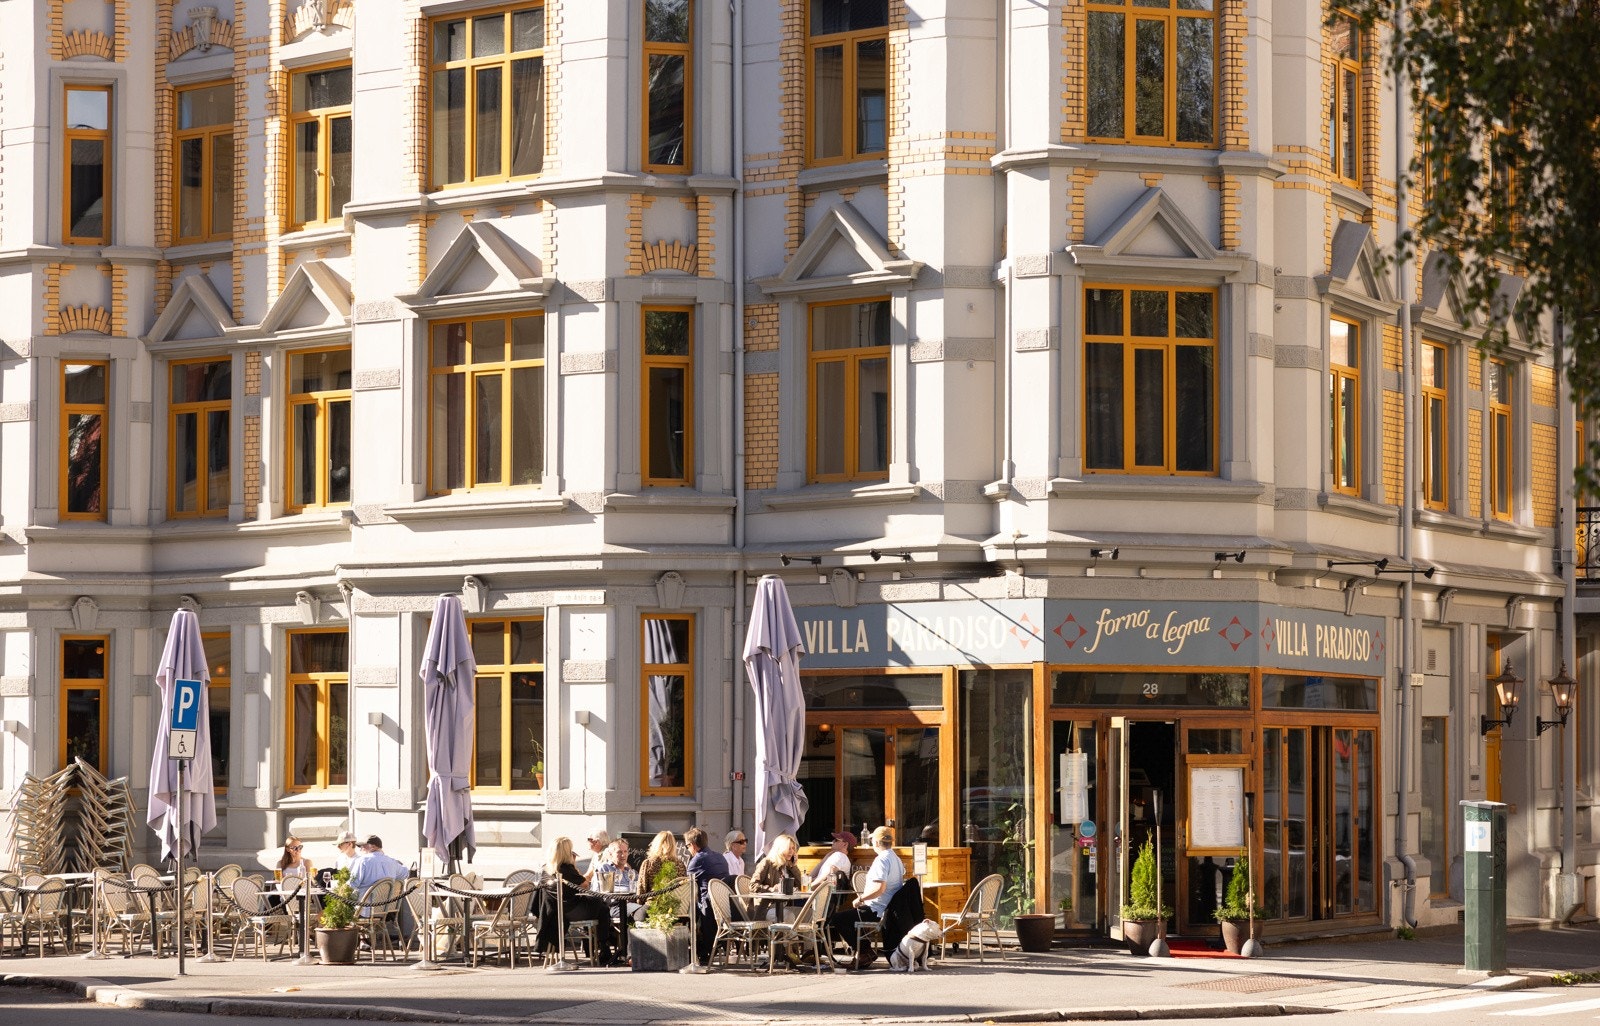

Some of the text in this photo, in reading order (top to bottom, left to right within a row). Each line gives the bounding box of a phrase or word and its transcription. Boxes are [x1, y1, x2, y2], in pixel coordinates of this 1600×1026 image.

[803, 614, 1008, 655] VILLA PARADISO
[1083, 608, 1211, 655] forno a legna
[1275, 618, 1370, 662] VILLA PARADISO
[177, 686, 194, 723] P
[1142, 683, 1158, 695] 28
